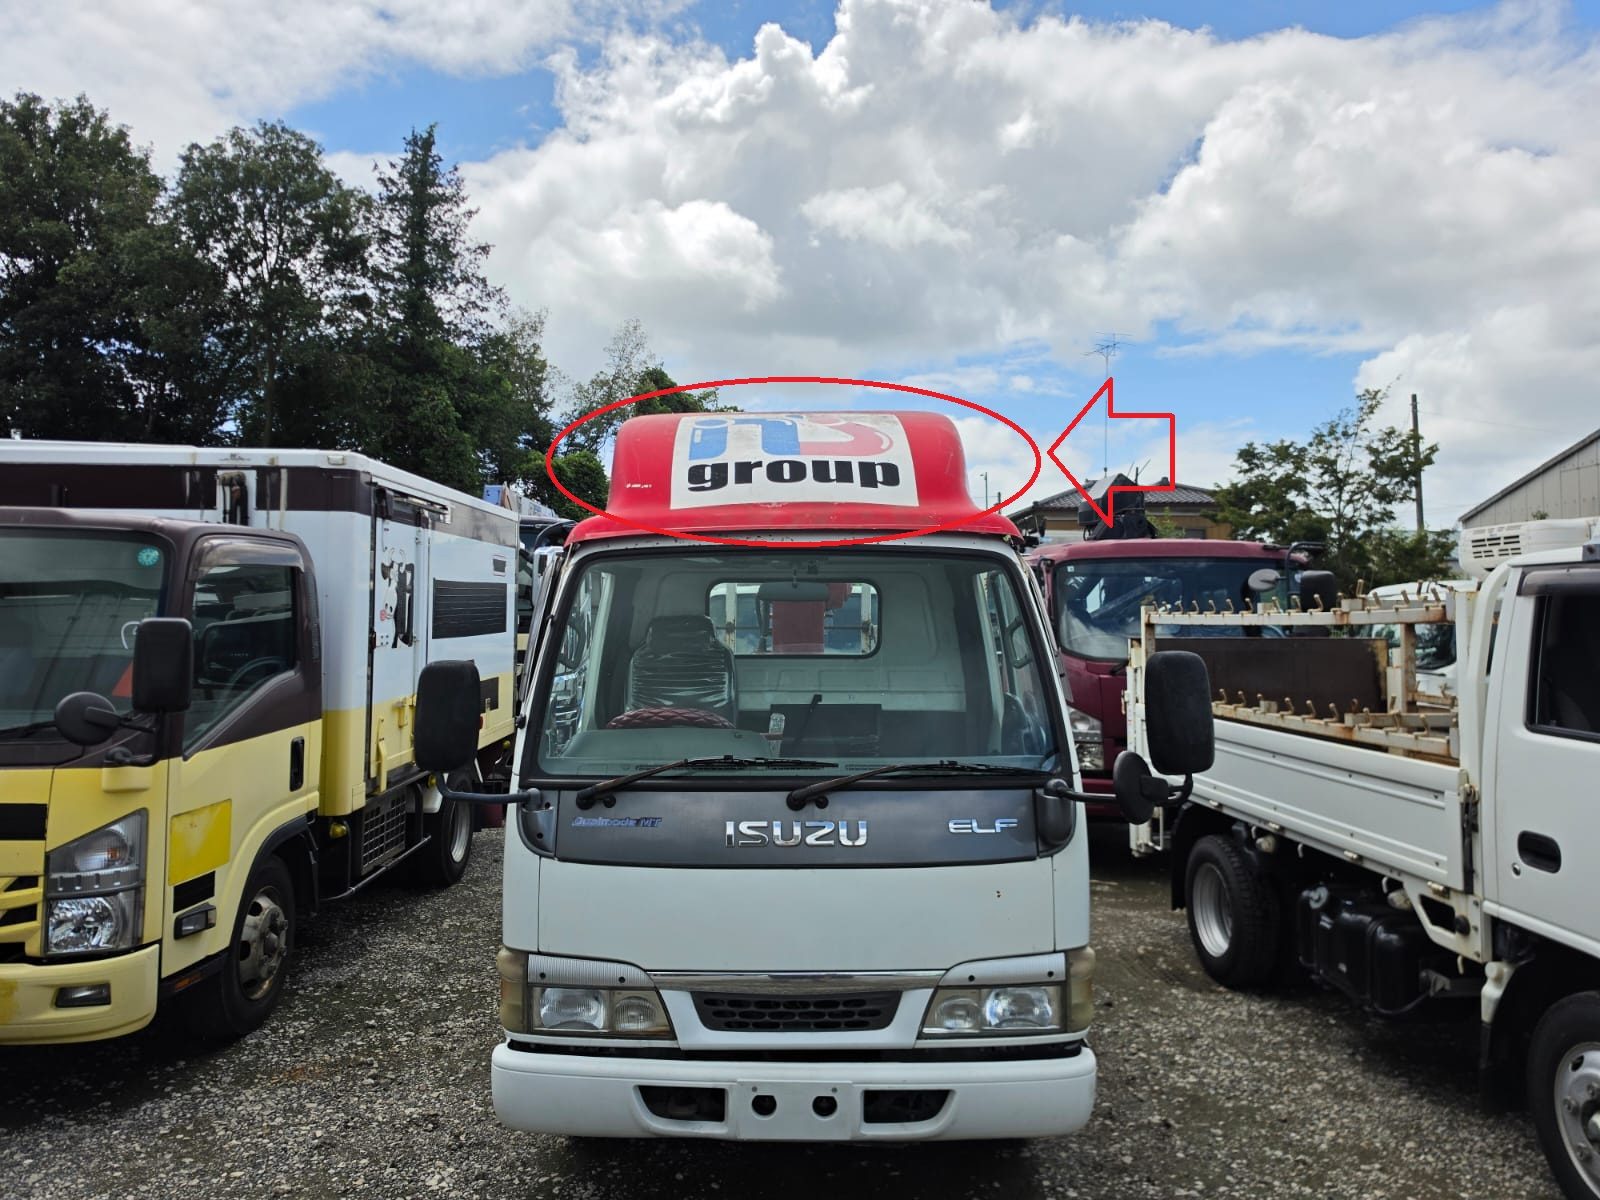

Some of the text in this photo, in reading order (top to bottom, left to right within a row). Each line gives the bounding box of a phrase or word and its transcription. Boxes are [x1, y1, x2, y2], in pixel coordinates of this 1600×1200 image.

[688, 460, 900, 491] group
[725, 821, 867, 846] ISUZU
[949, 818, 1018, 833] ELF
